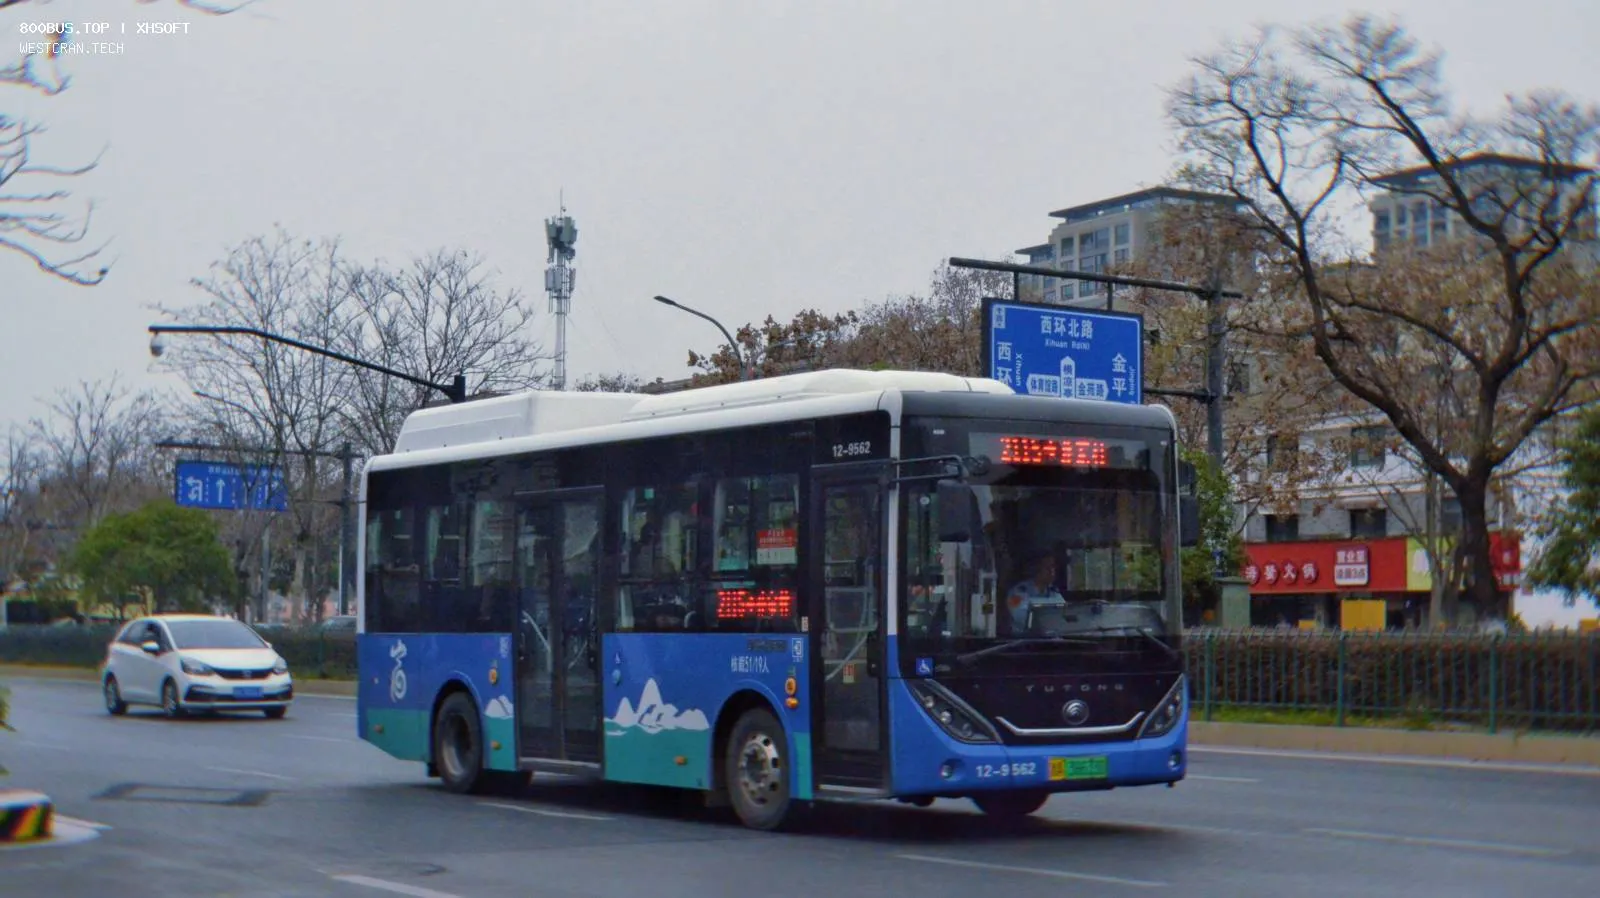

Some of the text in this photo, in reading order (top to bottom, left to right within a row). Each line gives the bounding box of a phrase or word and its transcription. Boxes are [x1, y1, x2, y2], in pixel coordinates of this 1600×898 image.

[1040, 315, 1094, 339] 西环北路
[1112, 353, 1127, 397] 金平
[832, 441, 871, 457] 12-9562
[1026, 684, 1124, 693] YUTONG
[976, 762, 1036, 777] 12-9562
